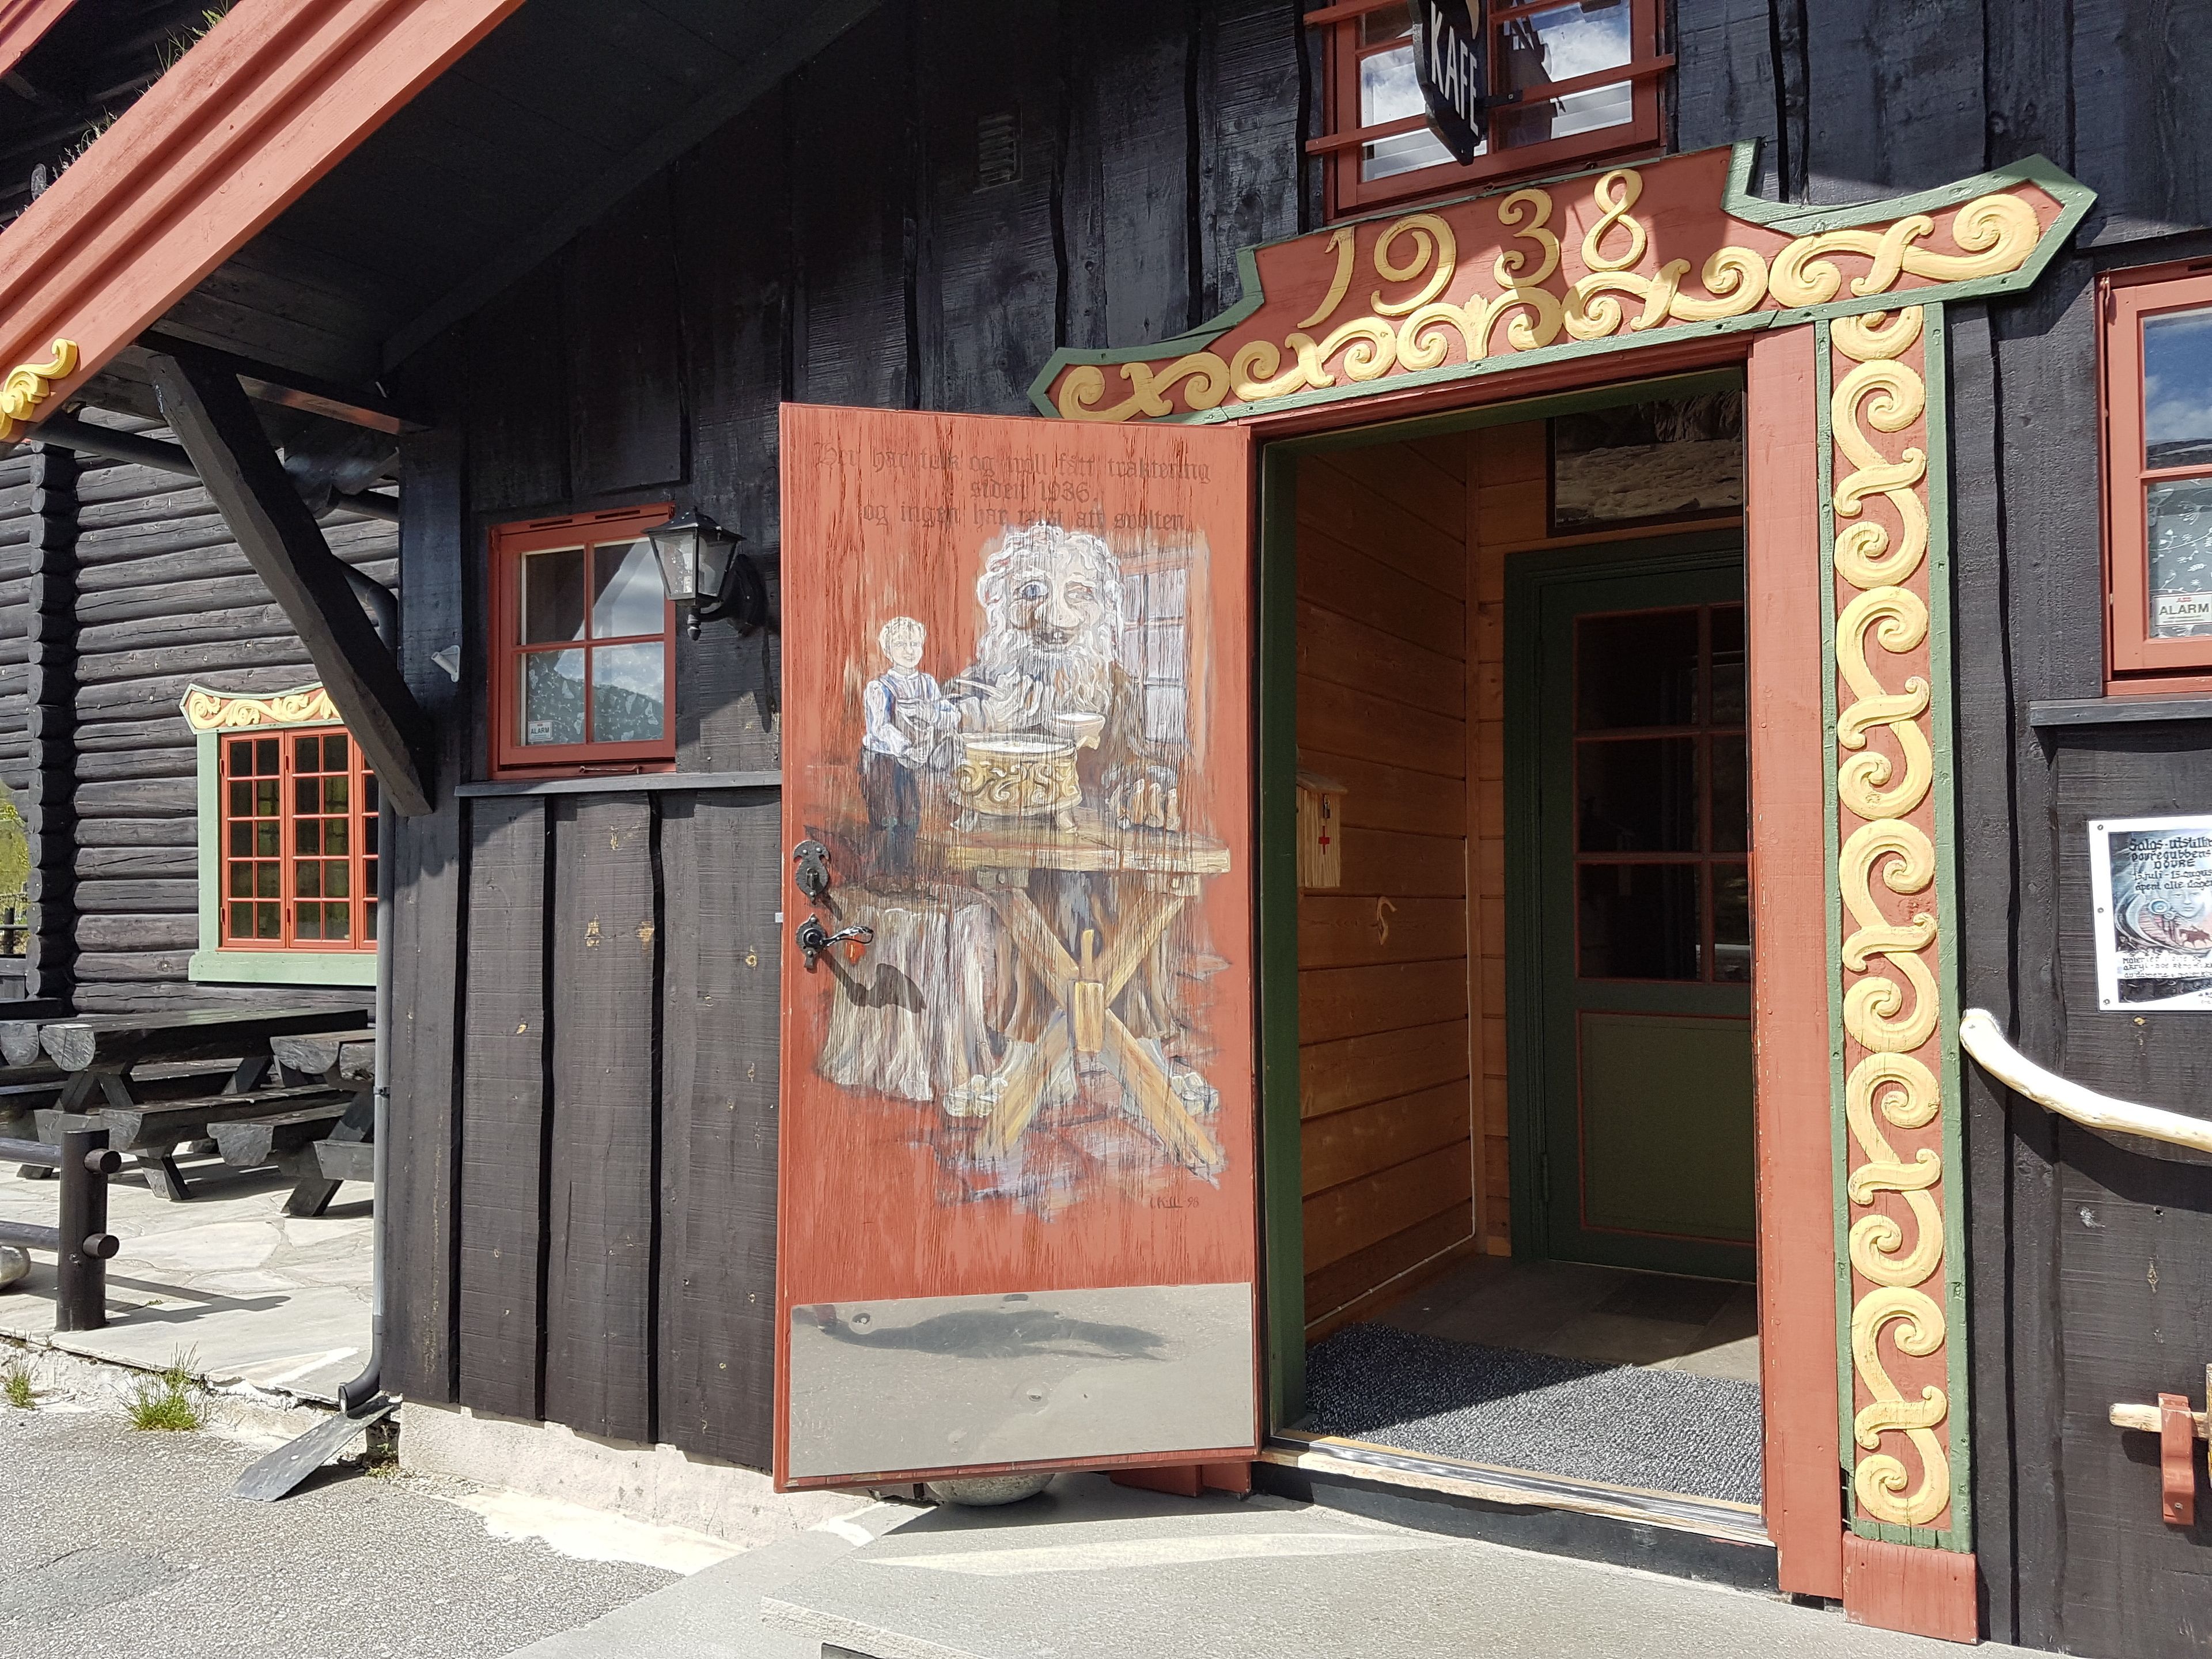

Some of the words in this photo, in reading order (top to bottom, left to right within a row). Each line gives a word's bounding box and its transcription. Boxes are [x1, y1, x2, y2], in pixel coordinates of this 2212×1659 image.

[1431, 1, 1479, 137] KAFE
[1297, 168, 1647, 329] 1938
[873, 444, 908, 472] har
[969, 453, 994, 478] og
[1108, 457, 1211, 484] traktering
[970, 478, 1028, 500] siden
[863, 504, 889, 527] og
[973, 501, 1008, 531] har
[2158, 603, 2210, 615] ALARM
[2153, 858, 2195, 869] DOVRE
